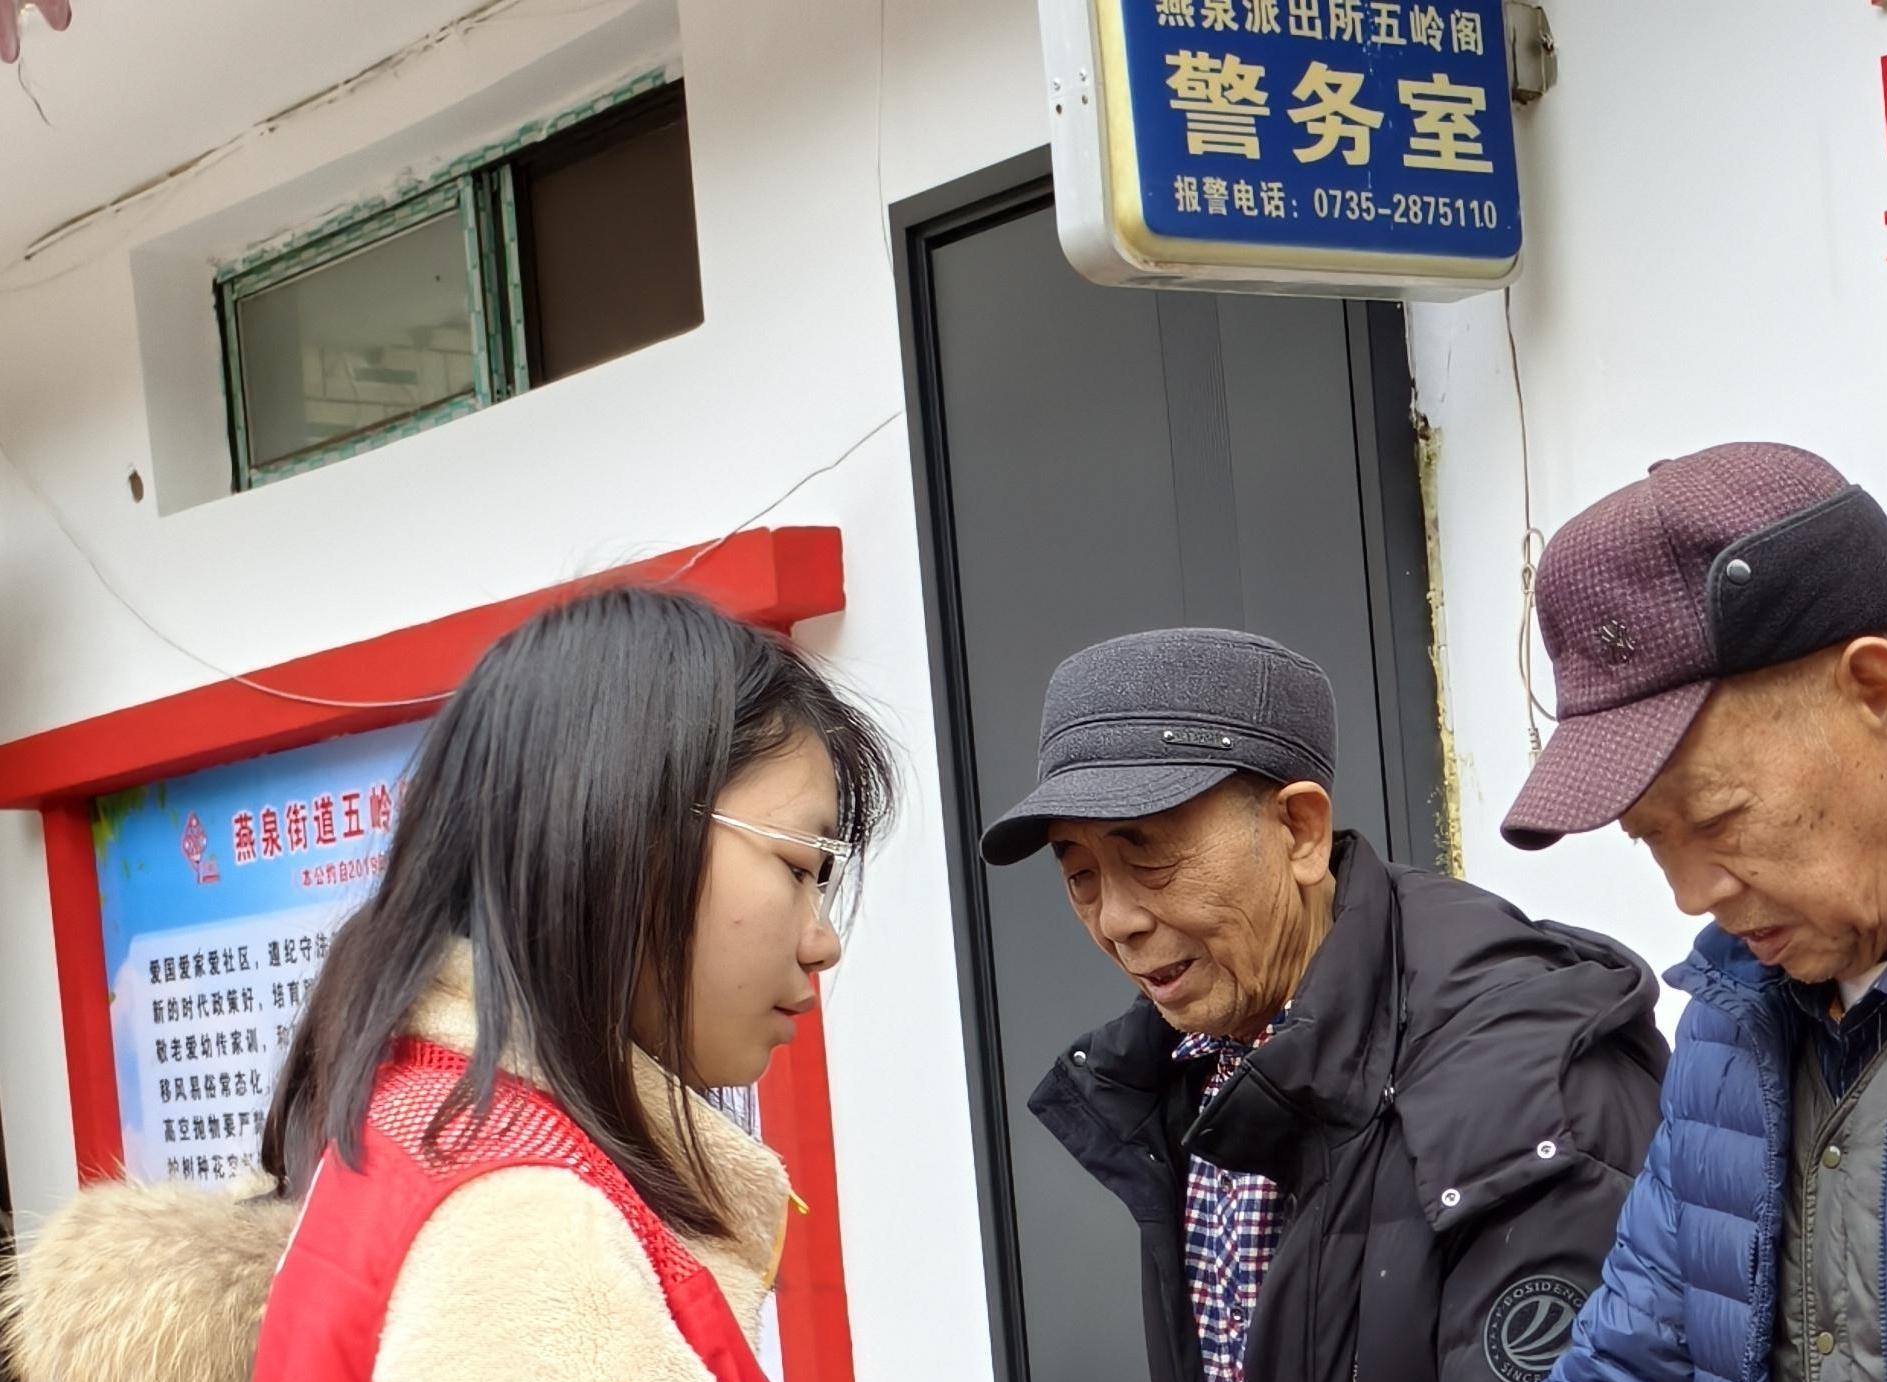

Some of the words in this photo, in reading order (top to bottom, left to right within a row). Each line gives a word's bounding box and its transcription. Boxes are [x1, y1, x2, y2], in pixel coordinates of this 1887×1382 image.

[1156, 0, 1483, 56] 燕泉派出所五岭阁
[1165, 48, 1494, 174] 警务室
[234, 778, 404, 862] 燕泉街道五岭
